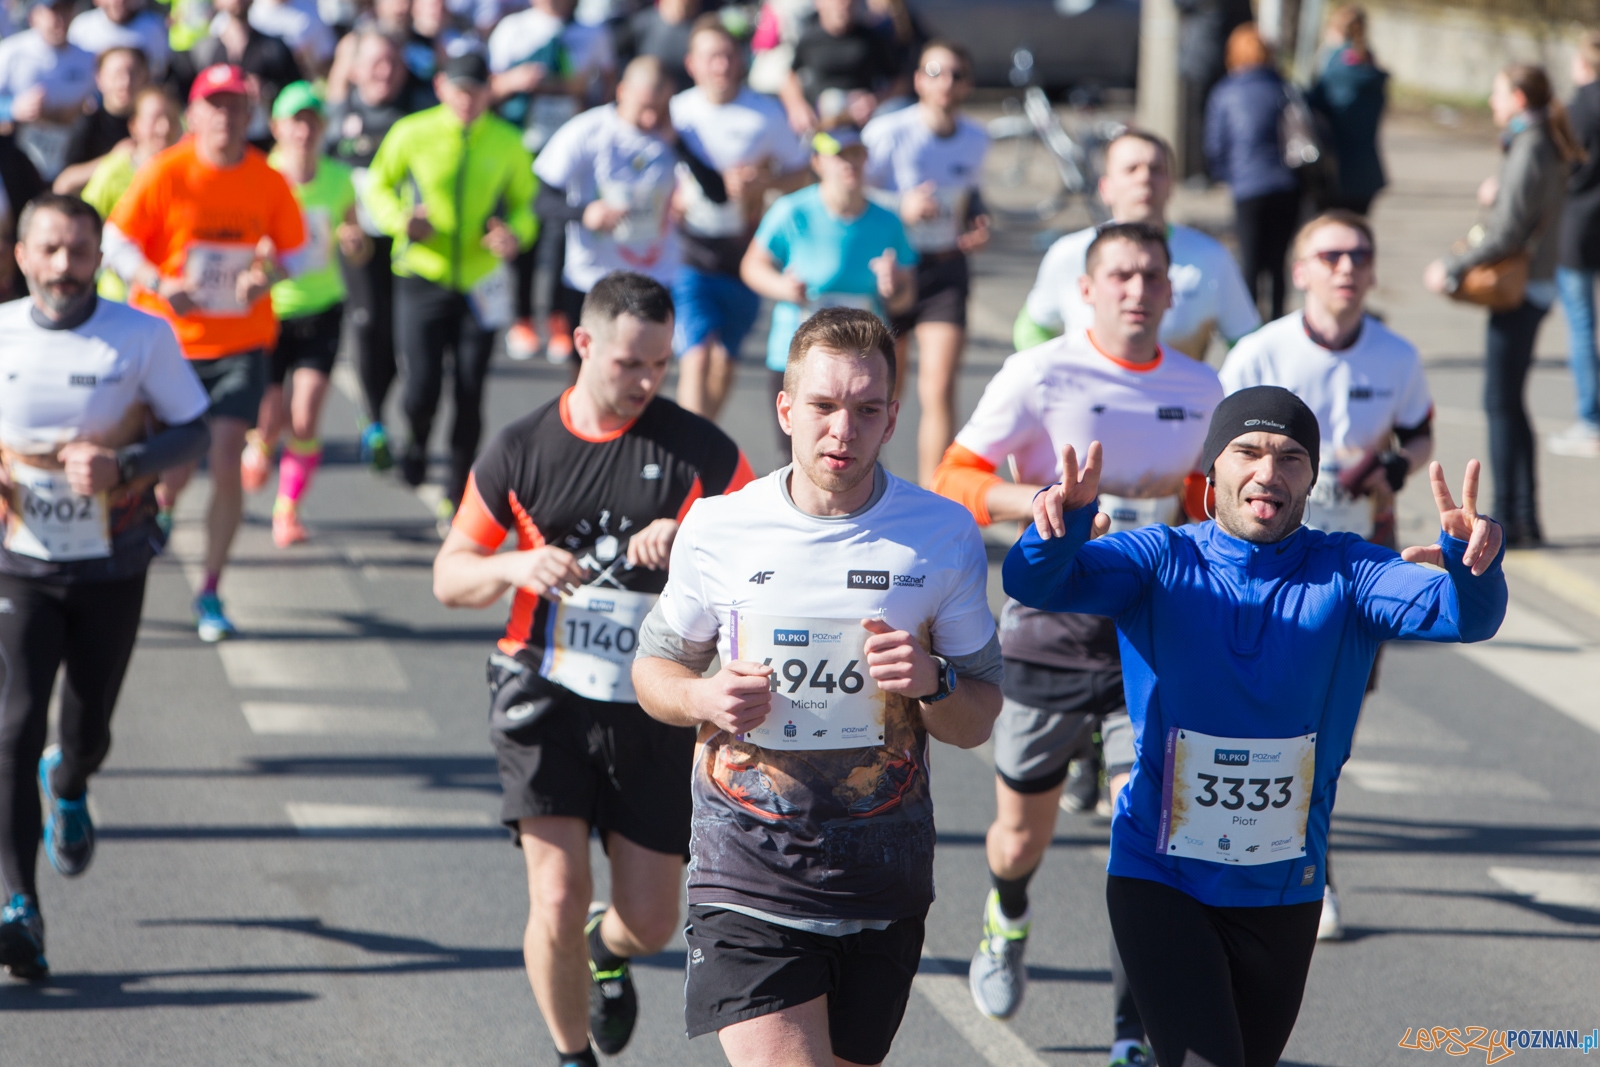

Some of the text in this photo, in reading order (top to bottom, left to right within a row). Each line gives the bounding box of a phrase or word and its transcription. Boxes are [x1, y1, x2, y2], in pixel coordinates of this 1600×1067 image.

[749, 571, 775, 585] 4F
[851, 574, 887, 586] 10. PKO
[566, 619, 637, 654] 1140
[776, 633, 807, 643] 10. PKO
[791, 699, 828, 709] Michal
[812, 729, 828, 738] 4F
[1217, 753, 1247, 762] 10. PKO
[1195, 772, 1294, 812] 3333
[1232, 815, 1258, 826] Piotr
[1245, 844, 1261, 853] 4F
